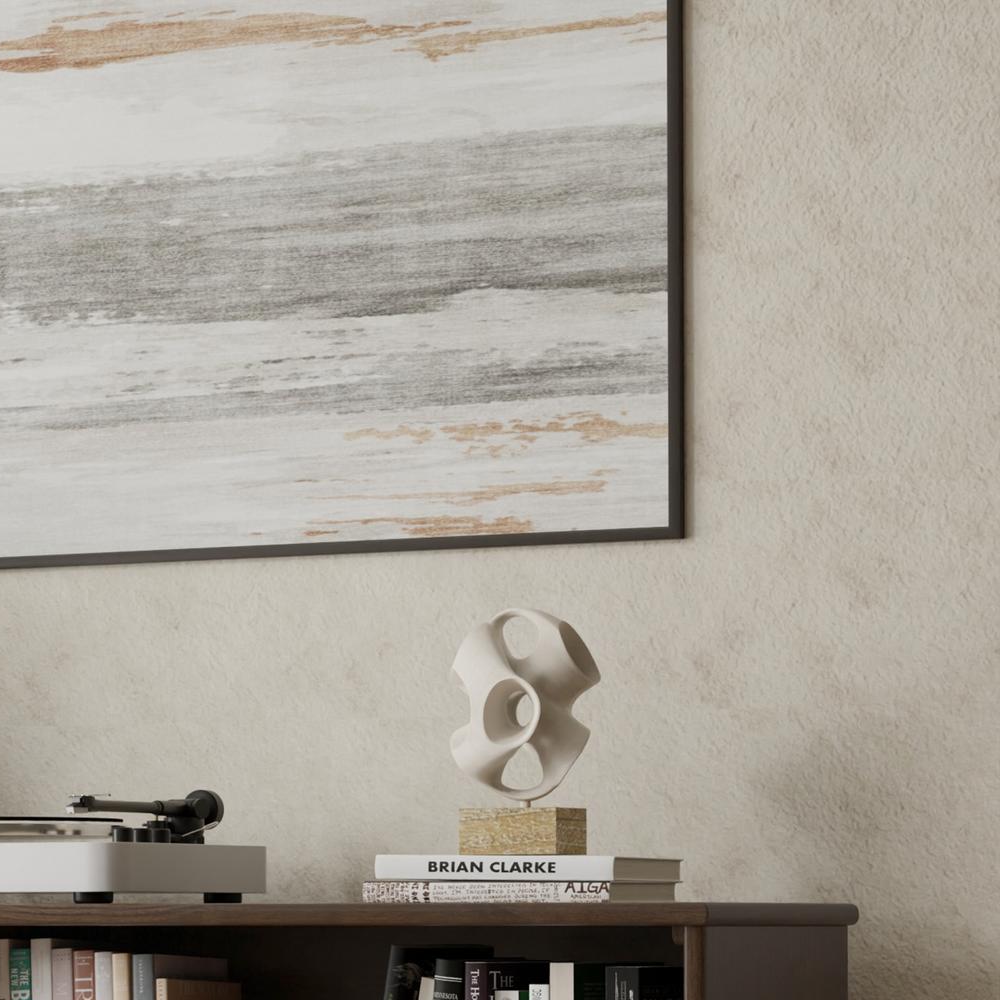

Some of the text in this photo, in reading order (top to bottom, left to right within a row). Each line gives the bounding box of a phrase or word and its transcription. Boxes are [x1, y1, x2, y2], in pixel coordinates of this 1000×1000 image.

[428, 860, 557, 873] BRIAN CLARKE
[565, 881, 610, 894] AIGA
[20, 970, 30, 988] THE
